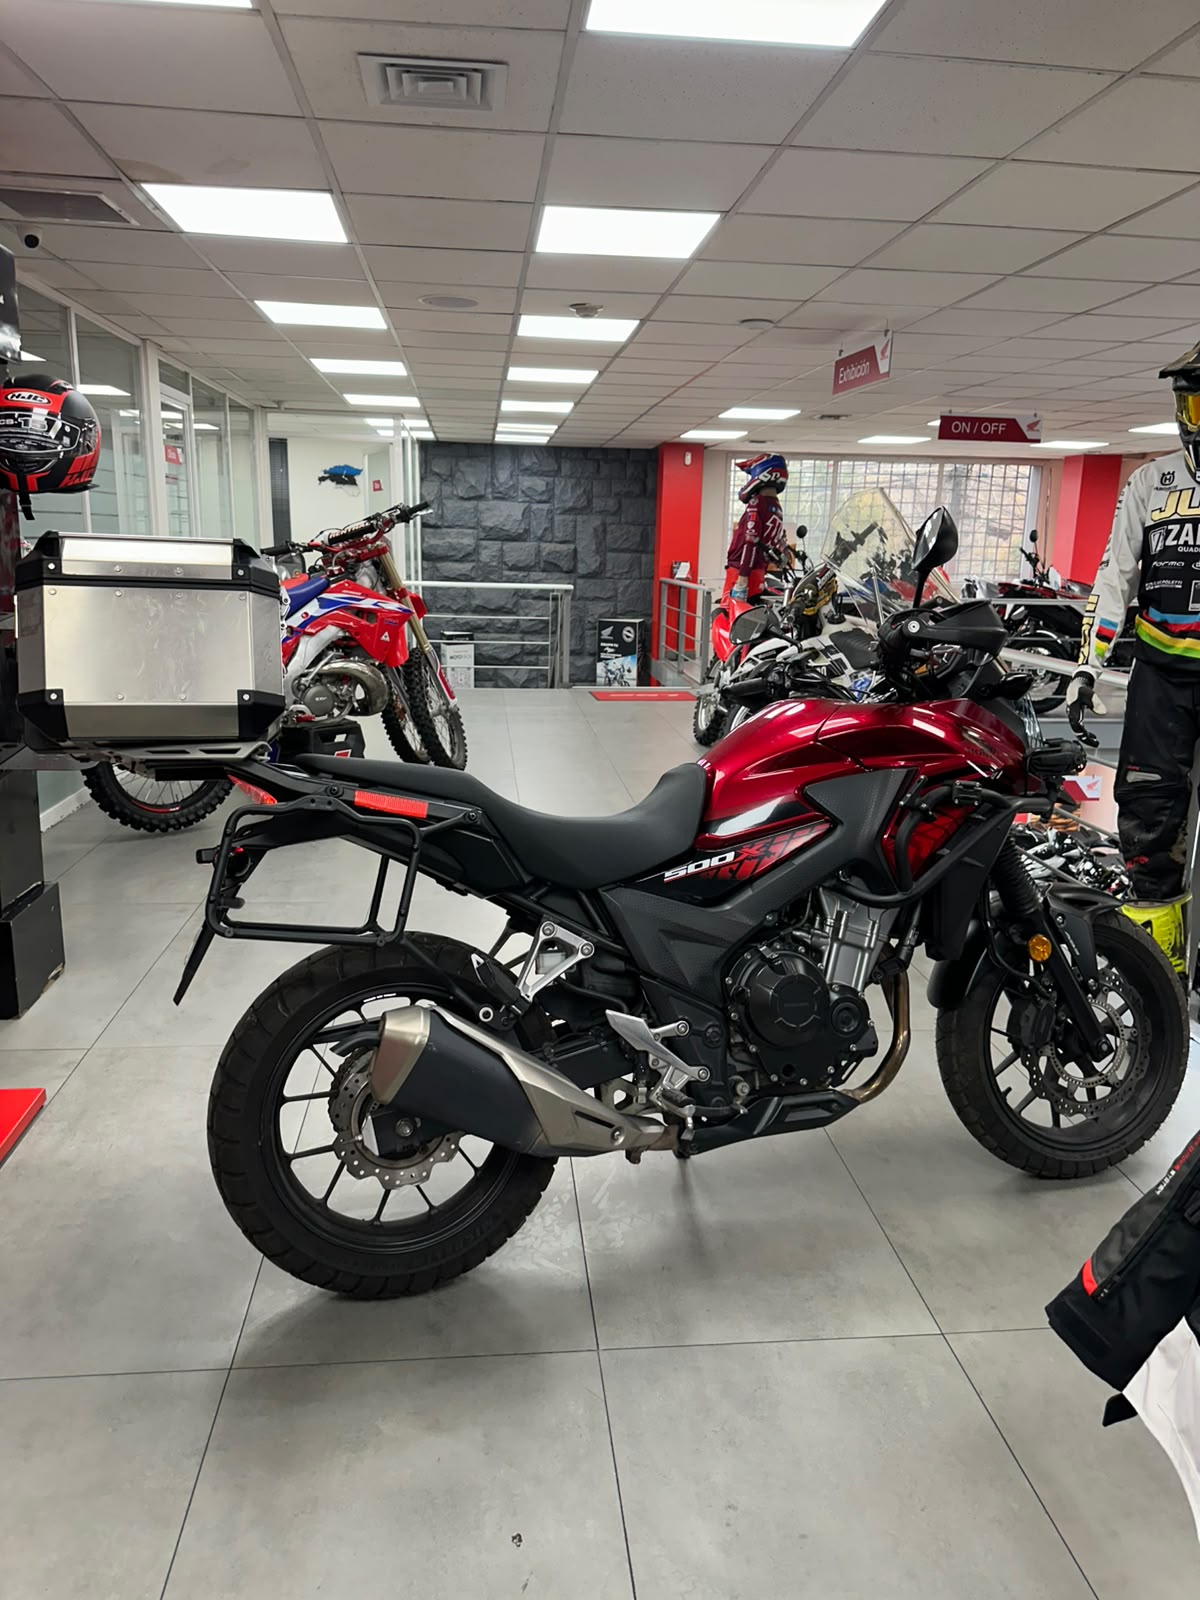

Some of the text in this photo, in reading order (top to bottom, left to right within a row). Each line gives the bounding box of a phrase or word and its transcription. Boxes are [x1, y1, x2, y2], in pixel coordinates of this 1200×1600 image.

[838, 359, 870, 384] Exhibición
[10, 393, 45, 403] HJC
[951, 421, 970, 434] ON
[981, 422, 1007, 436] OFF
[1165, 523, 1200, 546] ZA
